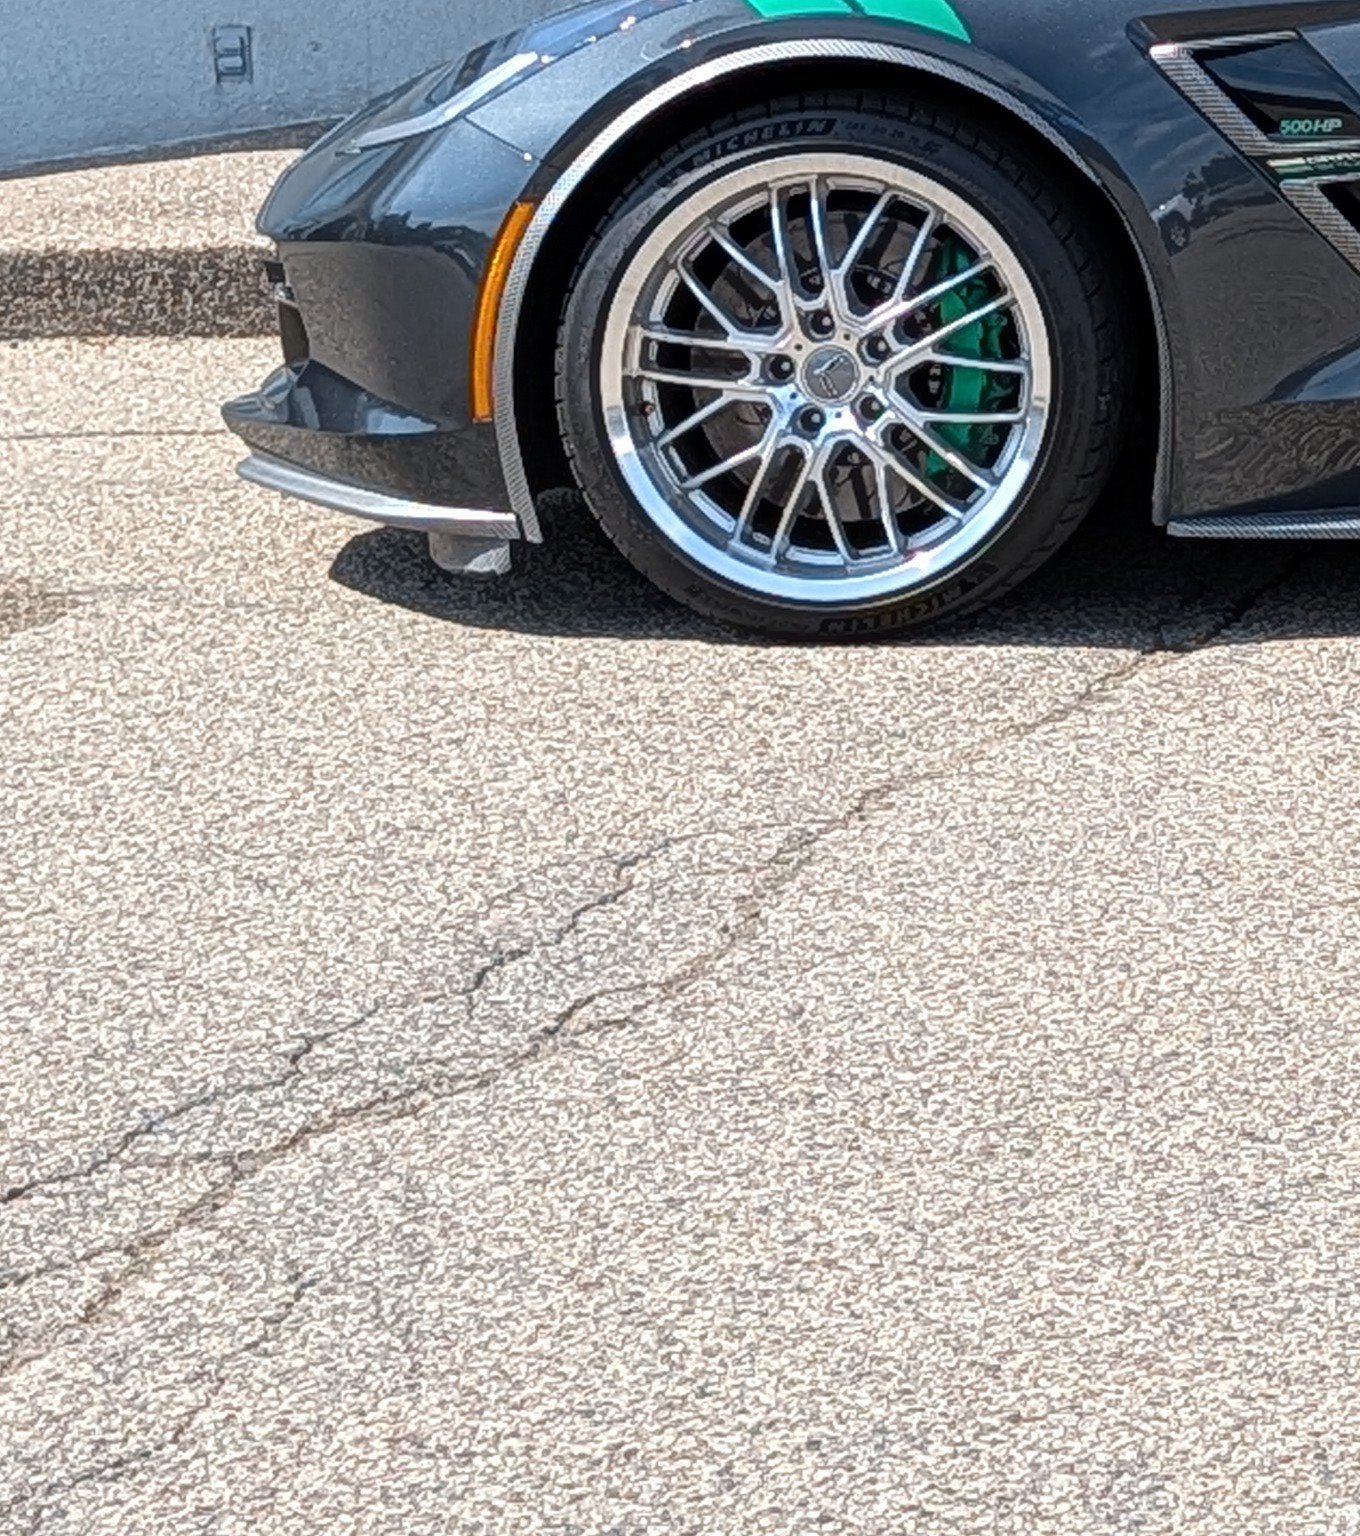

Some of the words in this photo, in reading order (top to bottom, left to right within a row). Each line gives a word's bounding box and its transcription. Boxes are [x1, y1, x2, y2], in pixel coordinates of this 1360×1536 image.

[1279, 119, 1312, 133] 500
[1313, 118, 1343, 132] HP
[693, 119, 827, 166] MICHELIN
